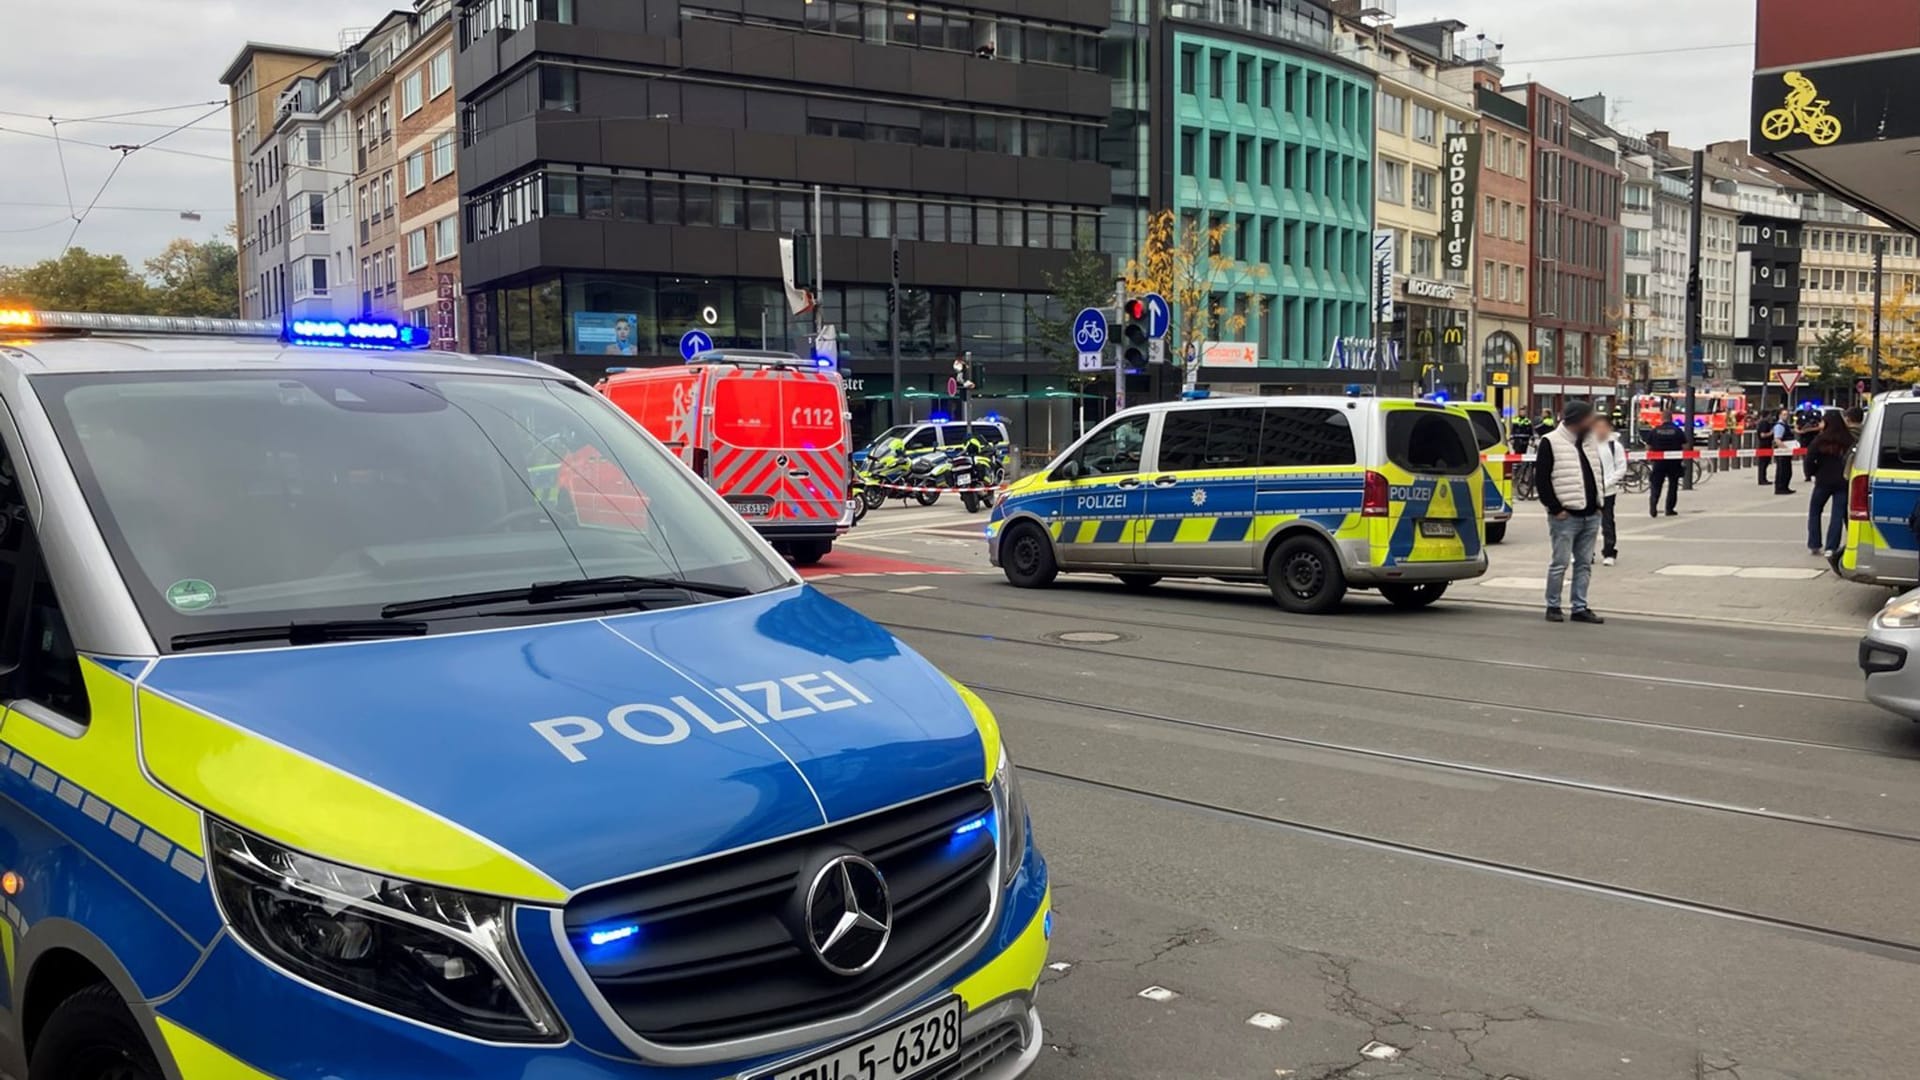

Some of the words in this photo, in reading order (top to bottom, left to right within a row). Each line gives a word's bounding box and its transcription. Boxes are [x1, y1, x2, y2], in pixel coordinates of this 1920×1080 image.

[1448, 137, 1467, 268] McDonald's
[803, 407, 834, 426] 112
[1077, 493, 1128, 509] POLIZEI
[1390, 486, 1432, 501] POLIZEI
[529, 671, 873, 763] POLIZEI
